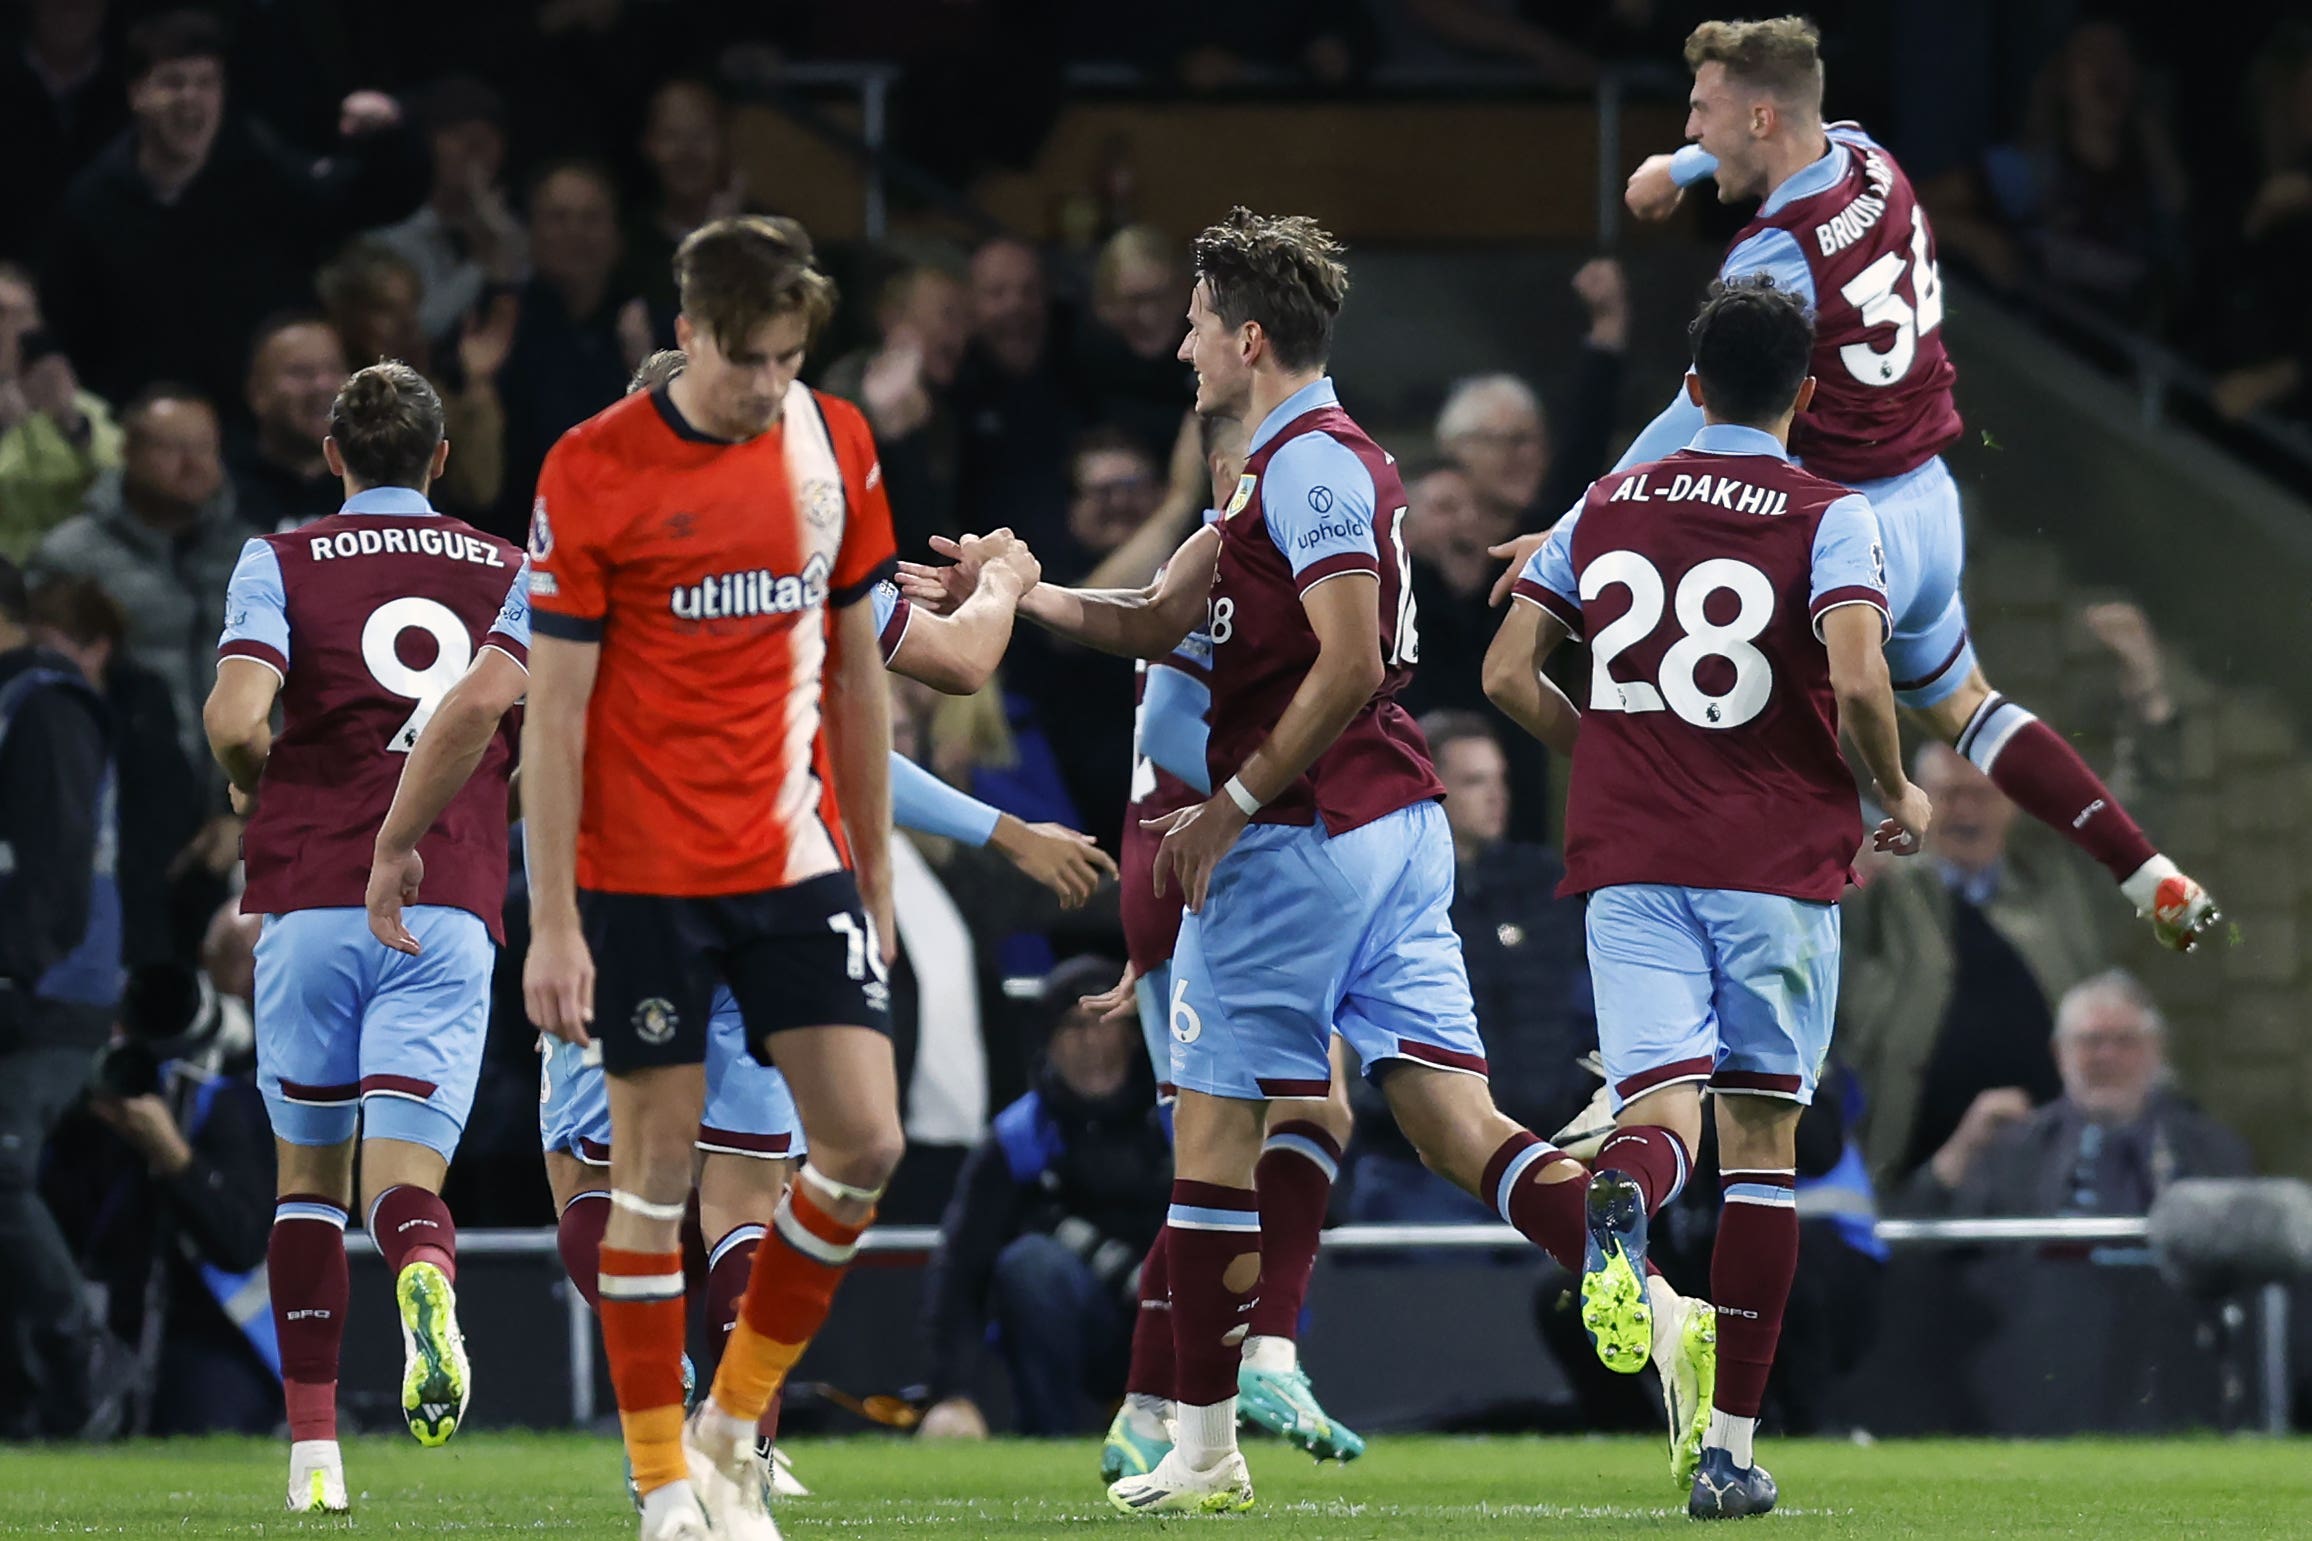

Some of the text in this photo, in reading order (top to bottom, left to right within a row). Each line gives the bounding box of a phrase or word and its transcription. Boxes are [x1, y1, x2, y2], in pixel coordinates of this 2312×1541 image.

[1815, 193, 1886, 257] BRUUN
[1839, 202, 1945, 387] 34
[1609, 474, 1788, 516] AL-DAKHIL
[310, 528, 505, 568] RODRIGUEZ
[1298, 518, 1364, 549] uphold
[671, 568, 801, 620] utilita
[1579, 550, 1775, 729] 28
[361, 596, 472, 753] 9
[1717, 1305, 1759, 1319] BFC
